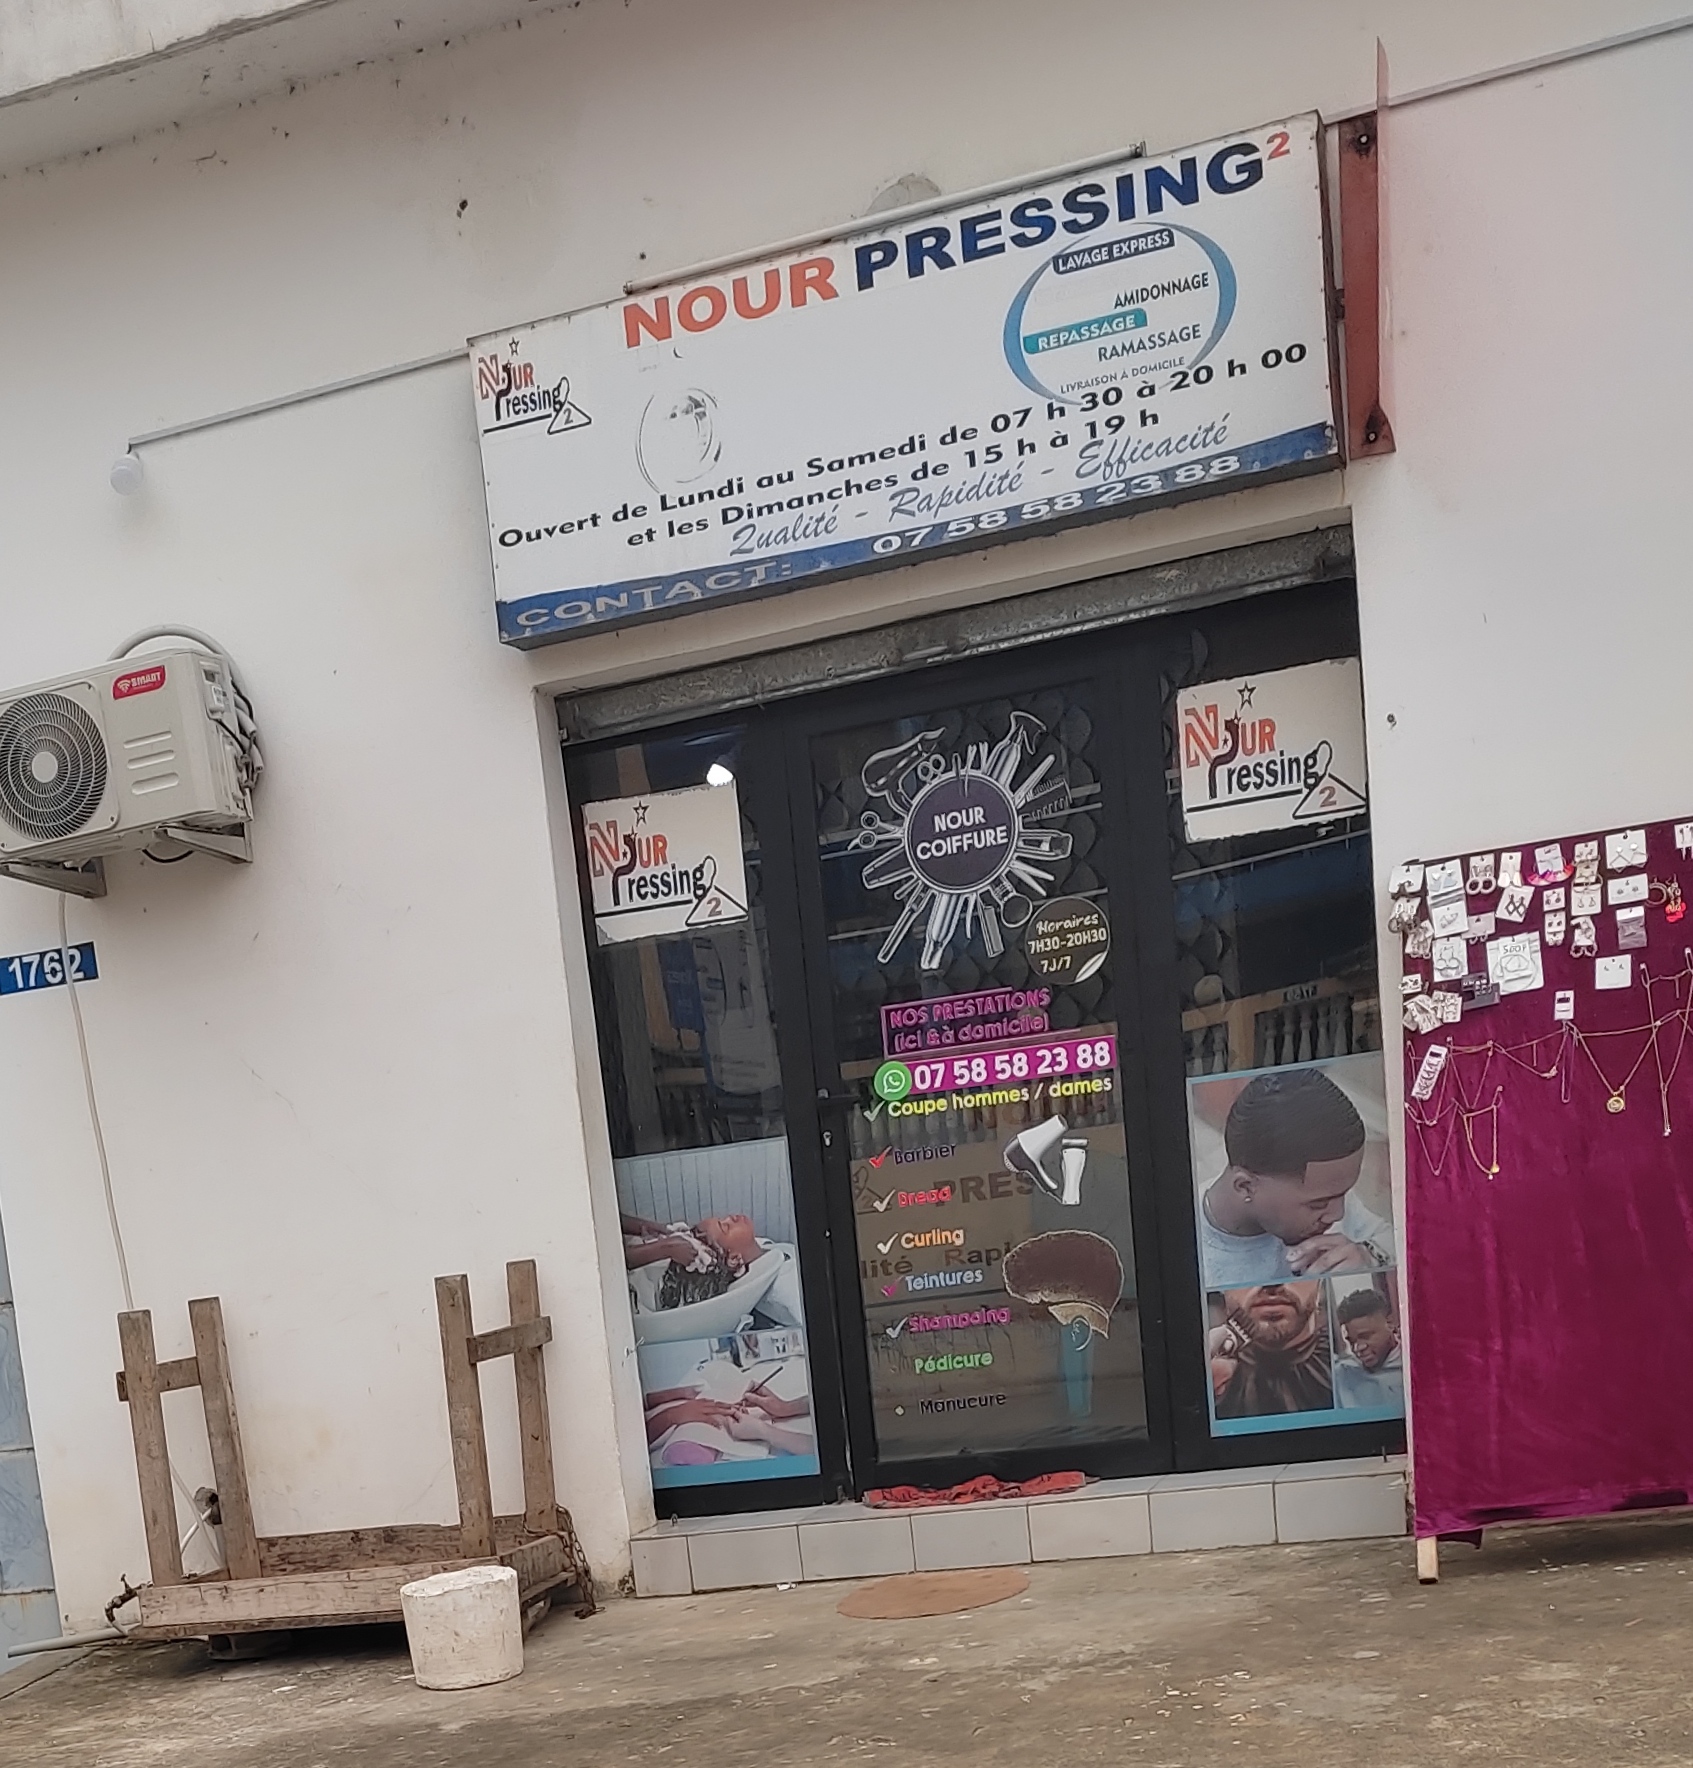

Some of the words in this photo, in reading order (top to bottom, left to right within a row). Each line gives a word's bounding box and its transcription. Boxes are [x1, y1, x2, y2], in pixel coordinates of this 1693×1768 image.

[623, 257, 839, 349] NOUR
[854, 142, 1264, 292] PRESSING
[1057, 246, 1110, 273] LAVAGE
[1111, 230, 1171, 260] EXPRESS
[1113, 272, 1209, 309] AMIDONNAGE
[1038, 315, 1137, 351] REPASSAGE
[1098, 324, 1202, 363] RAMASSAGE
[1060, 371, 1118, 394] LIVRAISON
[1131, 356, 1186, 379] DOMICILE
[498, 512, 601, 548] Ouvert
[612, 501, 648, 523] de
[660, 476, 745, 512] Lundi
[756, 468, 794, 490] au
[806, 426, 927, 478] Samedi
[938, 424, 979, 447] de
[990, 407, 1034, 435] 07
[1047, 398, 1067, 421] h
[1079, 386, 1124, 413] 30
[1136, 377, 1156, 398] à
[1169, 365, 1214, 393] 20
[1227, 358, 1248, 379] h
[1261, 343, 1307, 370] 00
[627, 526, 656, 547] et
[667, 515, 710, 539] les
[721, 472, 899, 526] Dimanches
[910, 460, 950, 484] de
[964, 444, 1003, 468] 15
[1017, 436, 1037, 457] h
[1050, 428, 1069, 449] à
[1085, 414, 1126, 440] 19
[1139, 409, 1160, 428] h
[729, 503, 840, 556] Qualité
[888, 460, 1025, 522] Rapidité
[1075, 412, 1231, 482] Efficacité
[516, 560, 793, 628] CONTACT:
[872, 526, 936, 555] 07
[946, 509, 1009, 540] 58
[1021, 492, 1085, 522] 58
[1095, 473, 1163, 504] 23
[1175, 455, 1242, 486] 88
[1318, 785, 1337, 808] 2
[933, 806, 986, 833] NOUR
[916, 825, 1009, 861] COIFFURE
[706, 897, 723, 918] 2
[1036, 912, 1099, 936] Horaires
[1027, 927, 1107, 955] 7H30-20H30
[8, 948, 85, 990] 1762
[1040, 955, 1072, 974] 7J/7
[890, 1006, 929, 1029] NOS
[932, 987, 1052, 1022] PRESTATIONS
[958, 1012, 1049, 1041] domicile)
[914, 1063, 946, 1090] 07
[953, 1058, 988, 1085] 58
[994, 1052, 1029, 1080] 58
[1036, 1047, 1069, 1075] 23
[1076, 1041, 1111, 1070] 88
[888, 1096, 948, 1117] Coupe
[952, 1086, 1030, 1110] hommes
[1034, 1082, 1044, 1100] /
[1048, 1076, 1113, 1099] dames
[894, 1144, 957, 1165] Barbier
[900, 1228, 965, 1250] Curling
[905, 1268, 984, 1292] Teintures
[909, 1306, 1011, 1333] Shampoing
[915, 1351, 994, 1375] Pédicure
[920, 1392, 1007, 1415] Manucure
